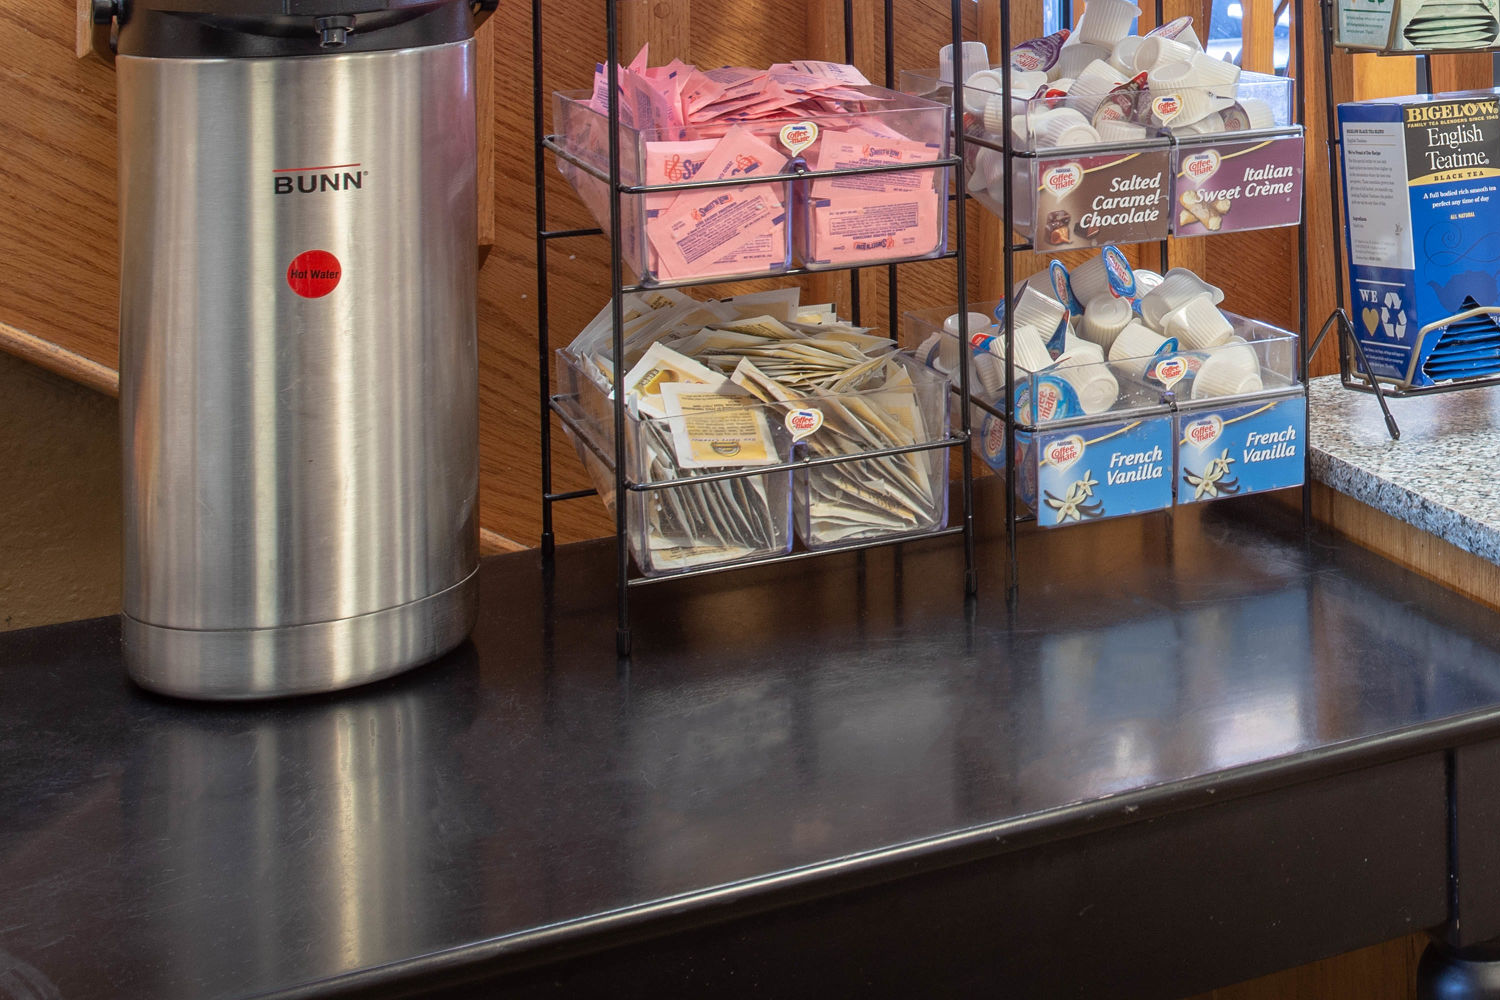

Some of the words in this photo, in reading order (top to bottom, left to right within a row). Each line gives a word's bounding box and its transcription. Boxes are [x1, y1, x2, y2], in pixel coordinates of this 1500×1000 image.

[1158, 102, 1177, 110] Coffee
[1406, 101, 1497, 122] BIGELOW
[787, 130, 808, 141] Coffee
[1427, 124, 1484, 148] English
[1189, 160, 1211, 172] Coffee
[1425, 148, 1486, 170] Teatime
[1194, 165, 1212, 176] mate
[1243, 164, 1293, 181] Italian
[274, 171, 362, 194] BUNN
[1050, 172, 1073, 185] Coffee
[1054, 179, 1075, 190] mate
[1110, 172, 1161, 192] Salted
[1092, 189, 1160, 210] Caramel
[1197, 186, 1241, 203] Sweet
[1245, 181, 1293, 198] Crème
[1440, 189, 1458, 197] bodied
[1080, 208, 1159, 228] Chocolate
[290, 269, 307, 279] Hot
[310, 269, 339, 279] Water
[1359, 288, 1378, 303] WE
[1162, 366, 1180, 375] Coffee
[792, 416, 813, 425] Coffee
[1191, 425, 1214, 439] Coffee
[1196, 430, 1216, 443] mate
[1246, 424, 1296, 447] French
[1051, 445, 1075, 460] Coffee
[1056, 451, 1078, 464] mate
[1110, 446, 1163, 469] French
[1243, 442, 1296, 464] Vanilla
[1107, 463, 1163, 485] Vanilla
